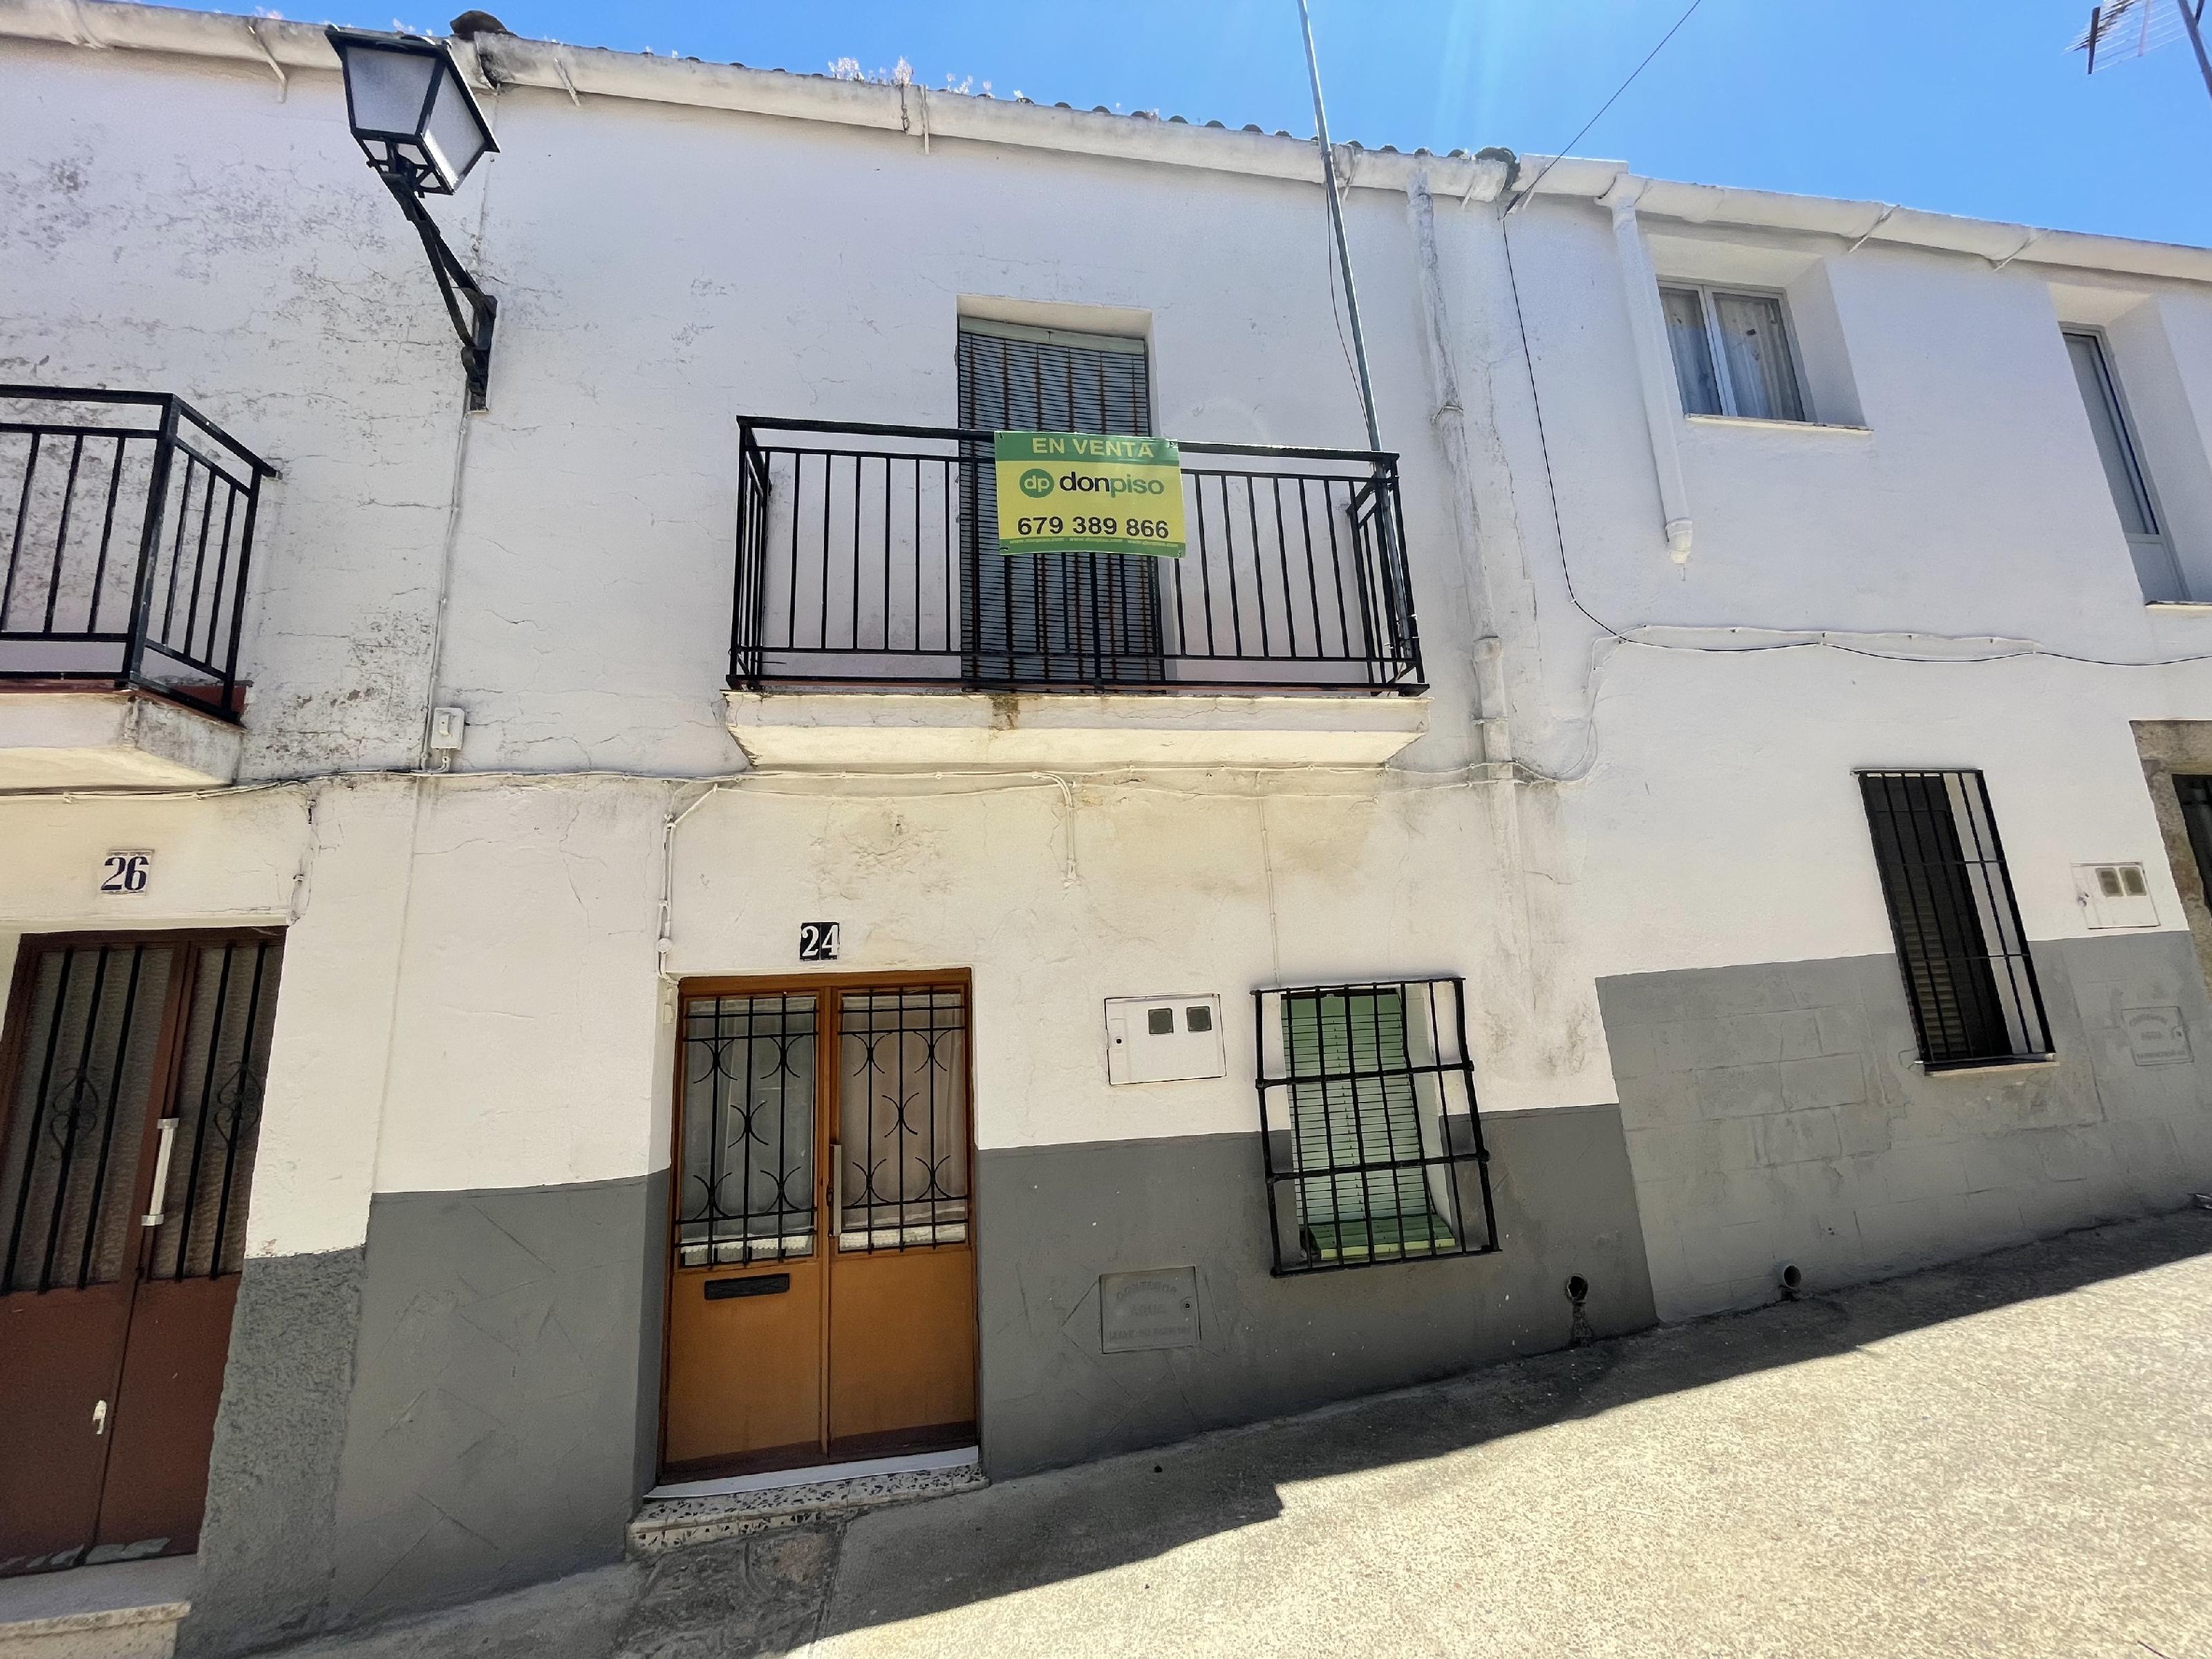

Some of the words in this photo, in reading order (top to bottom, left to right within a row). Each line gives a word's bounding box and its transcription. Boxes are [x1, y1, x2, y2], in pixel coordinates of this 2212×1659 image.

[1033, 438, 1065, 453] EN
[1073, 439, 1154, 458] VENTA
[1023, 475, 1051, 492] dp
[1059, 471, 1165, 498] donpiso
[1018, 516, 1063, 535] 679
[1073, 516, 1117, 534] 389
[1126, 518, 1169, 538] 866
[100, 856, 149, 890] 26
[802, 925, 840, 957] 24
